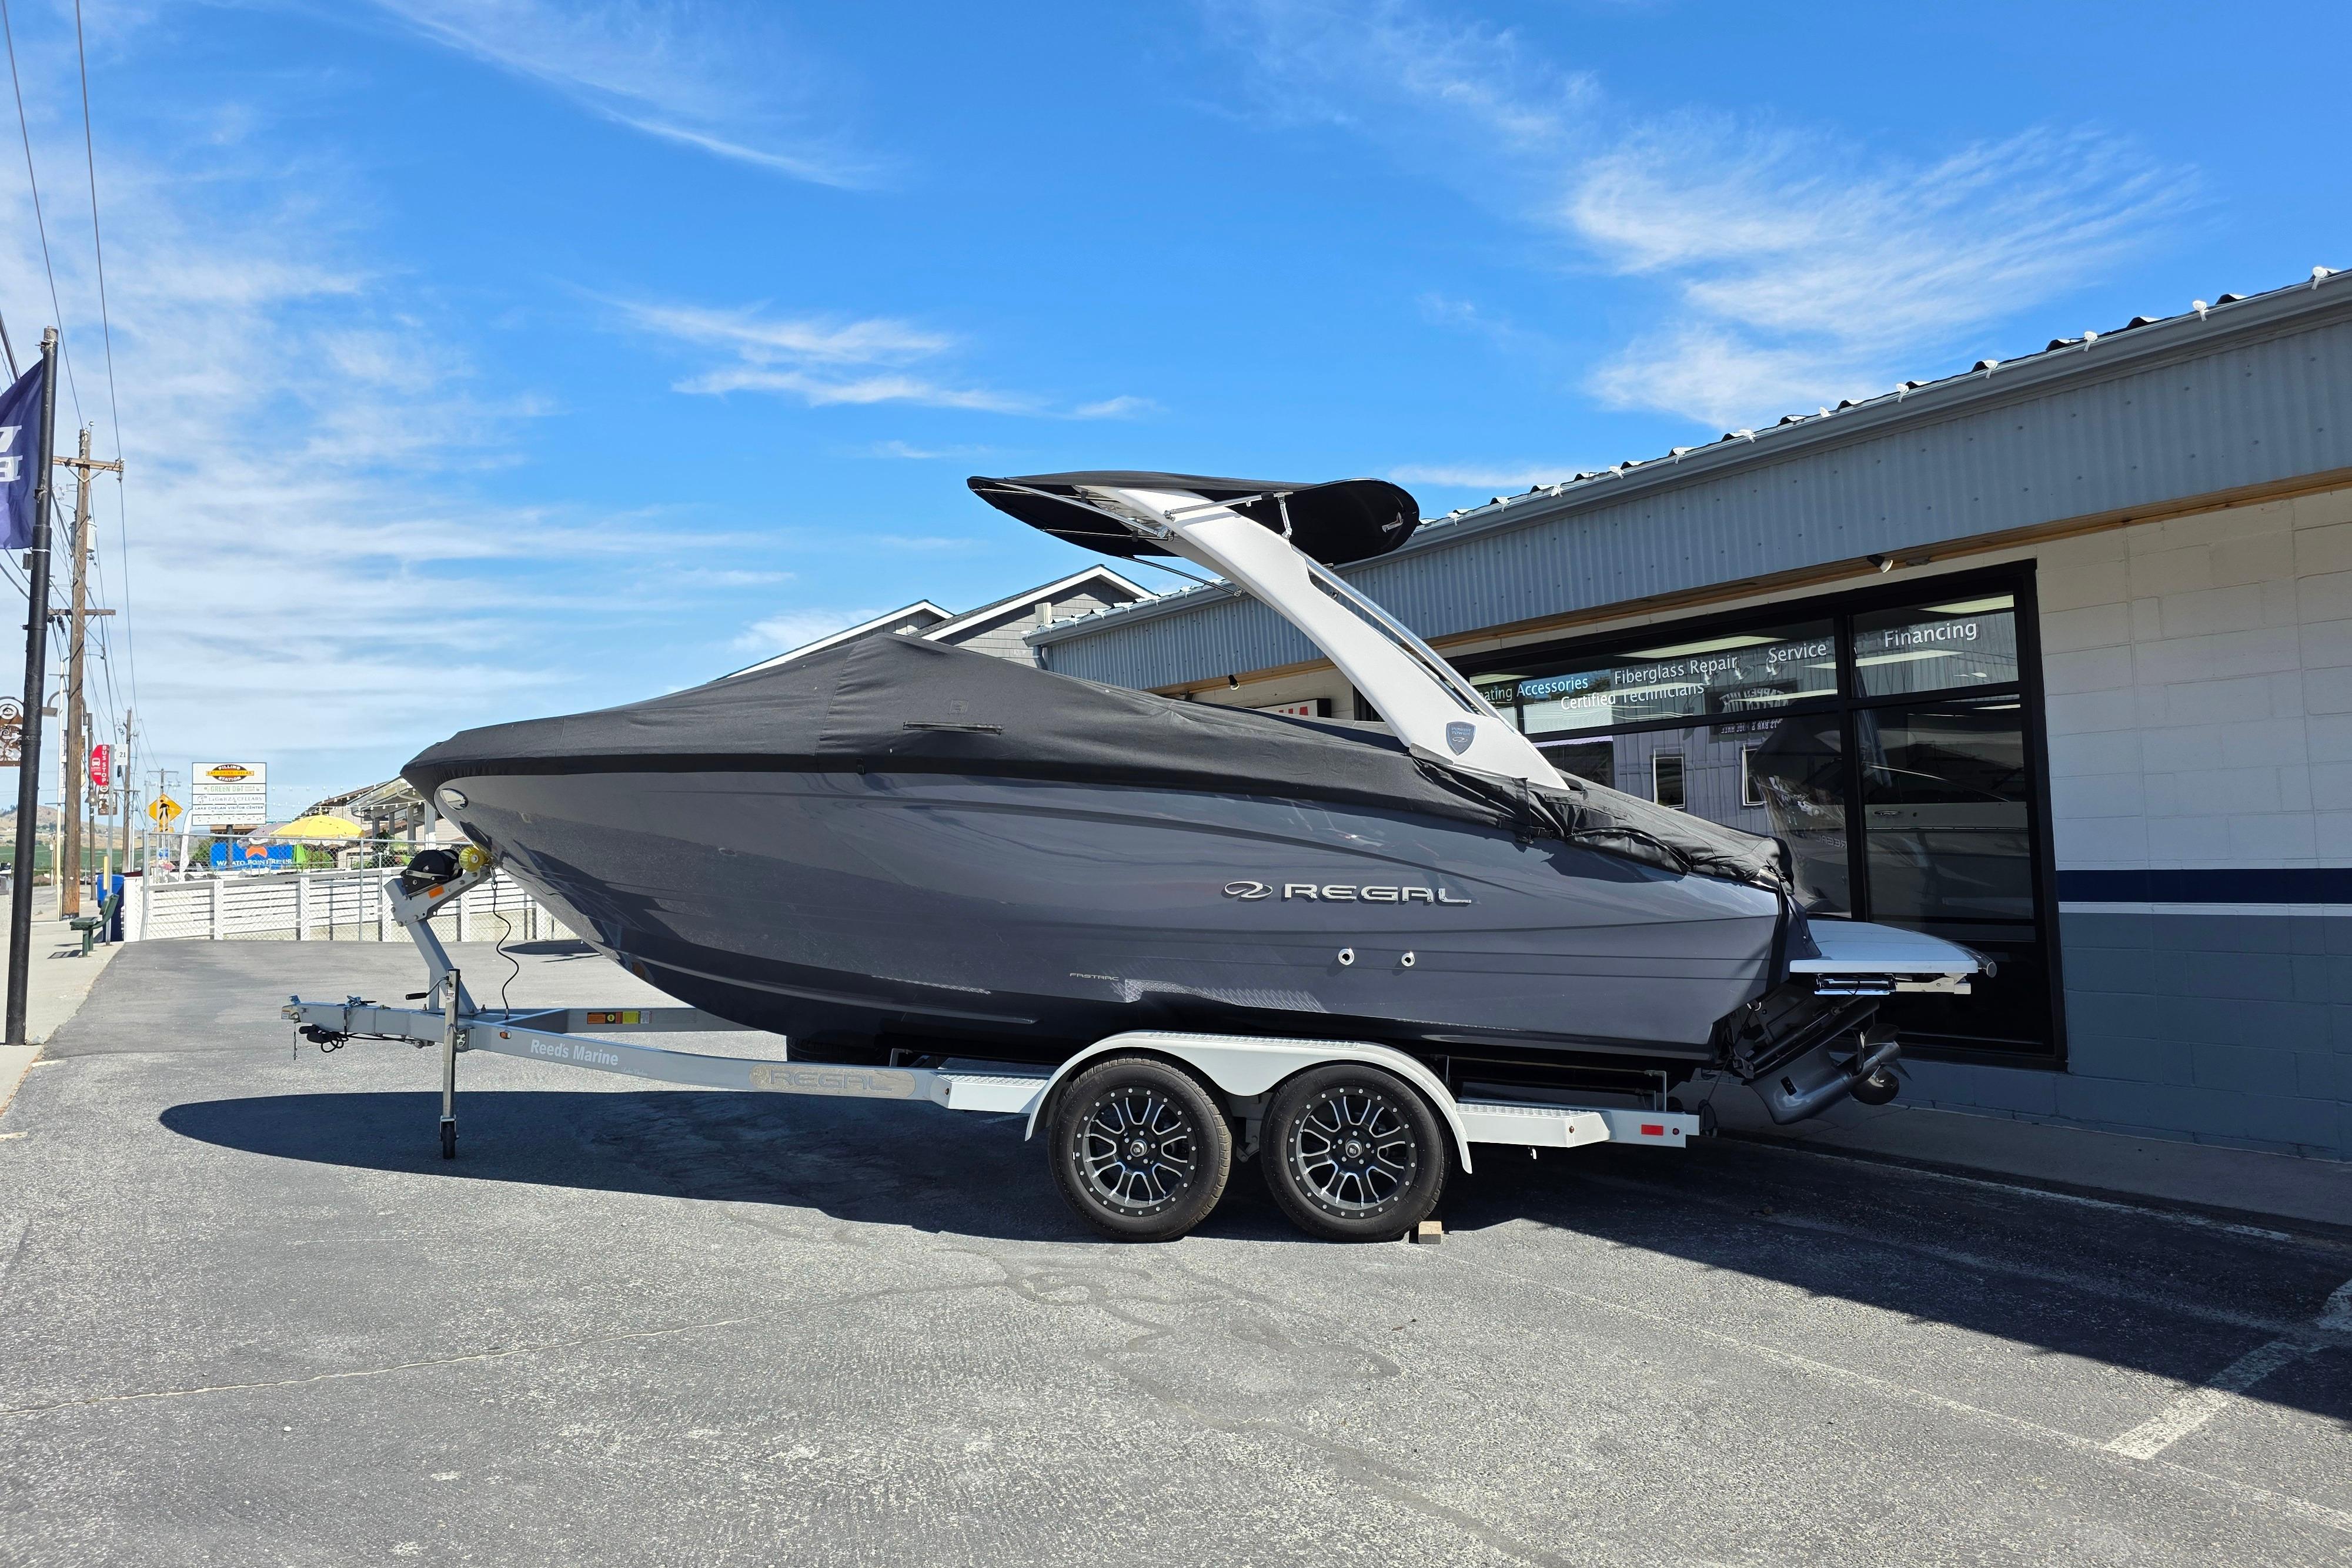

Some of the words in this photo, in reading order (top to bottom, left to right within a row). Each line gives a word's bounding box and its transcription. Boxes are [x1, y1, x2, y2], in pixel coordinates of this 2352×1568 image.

[1885, 623, 1977, 648] Financing
[1768, 643, 1827, 664] Service
[1614, 663, 1685, 685] Fiberglass
[1690, 655, 1738, 676] Repair
[1516, 677, 1588, 697] Accessories
[1561, 692, 1616, 711] Certified
[1621, 683, 1705, 703] Technicians
[1284, 883, 1472, 904] REGAL
[1070, 972, 1120, 981] FASTRAC
[530, 1039, 569, 1058] Reed's
[573, 1045, 619, 1066] Marine
[770, 1069, 893, 1091] REGAL
